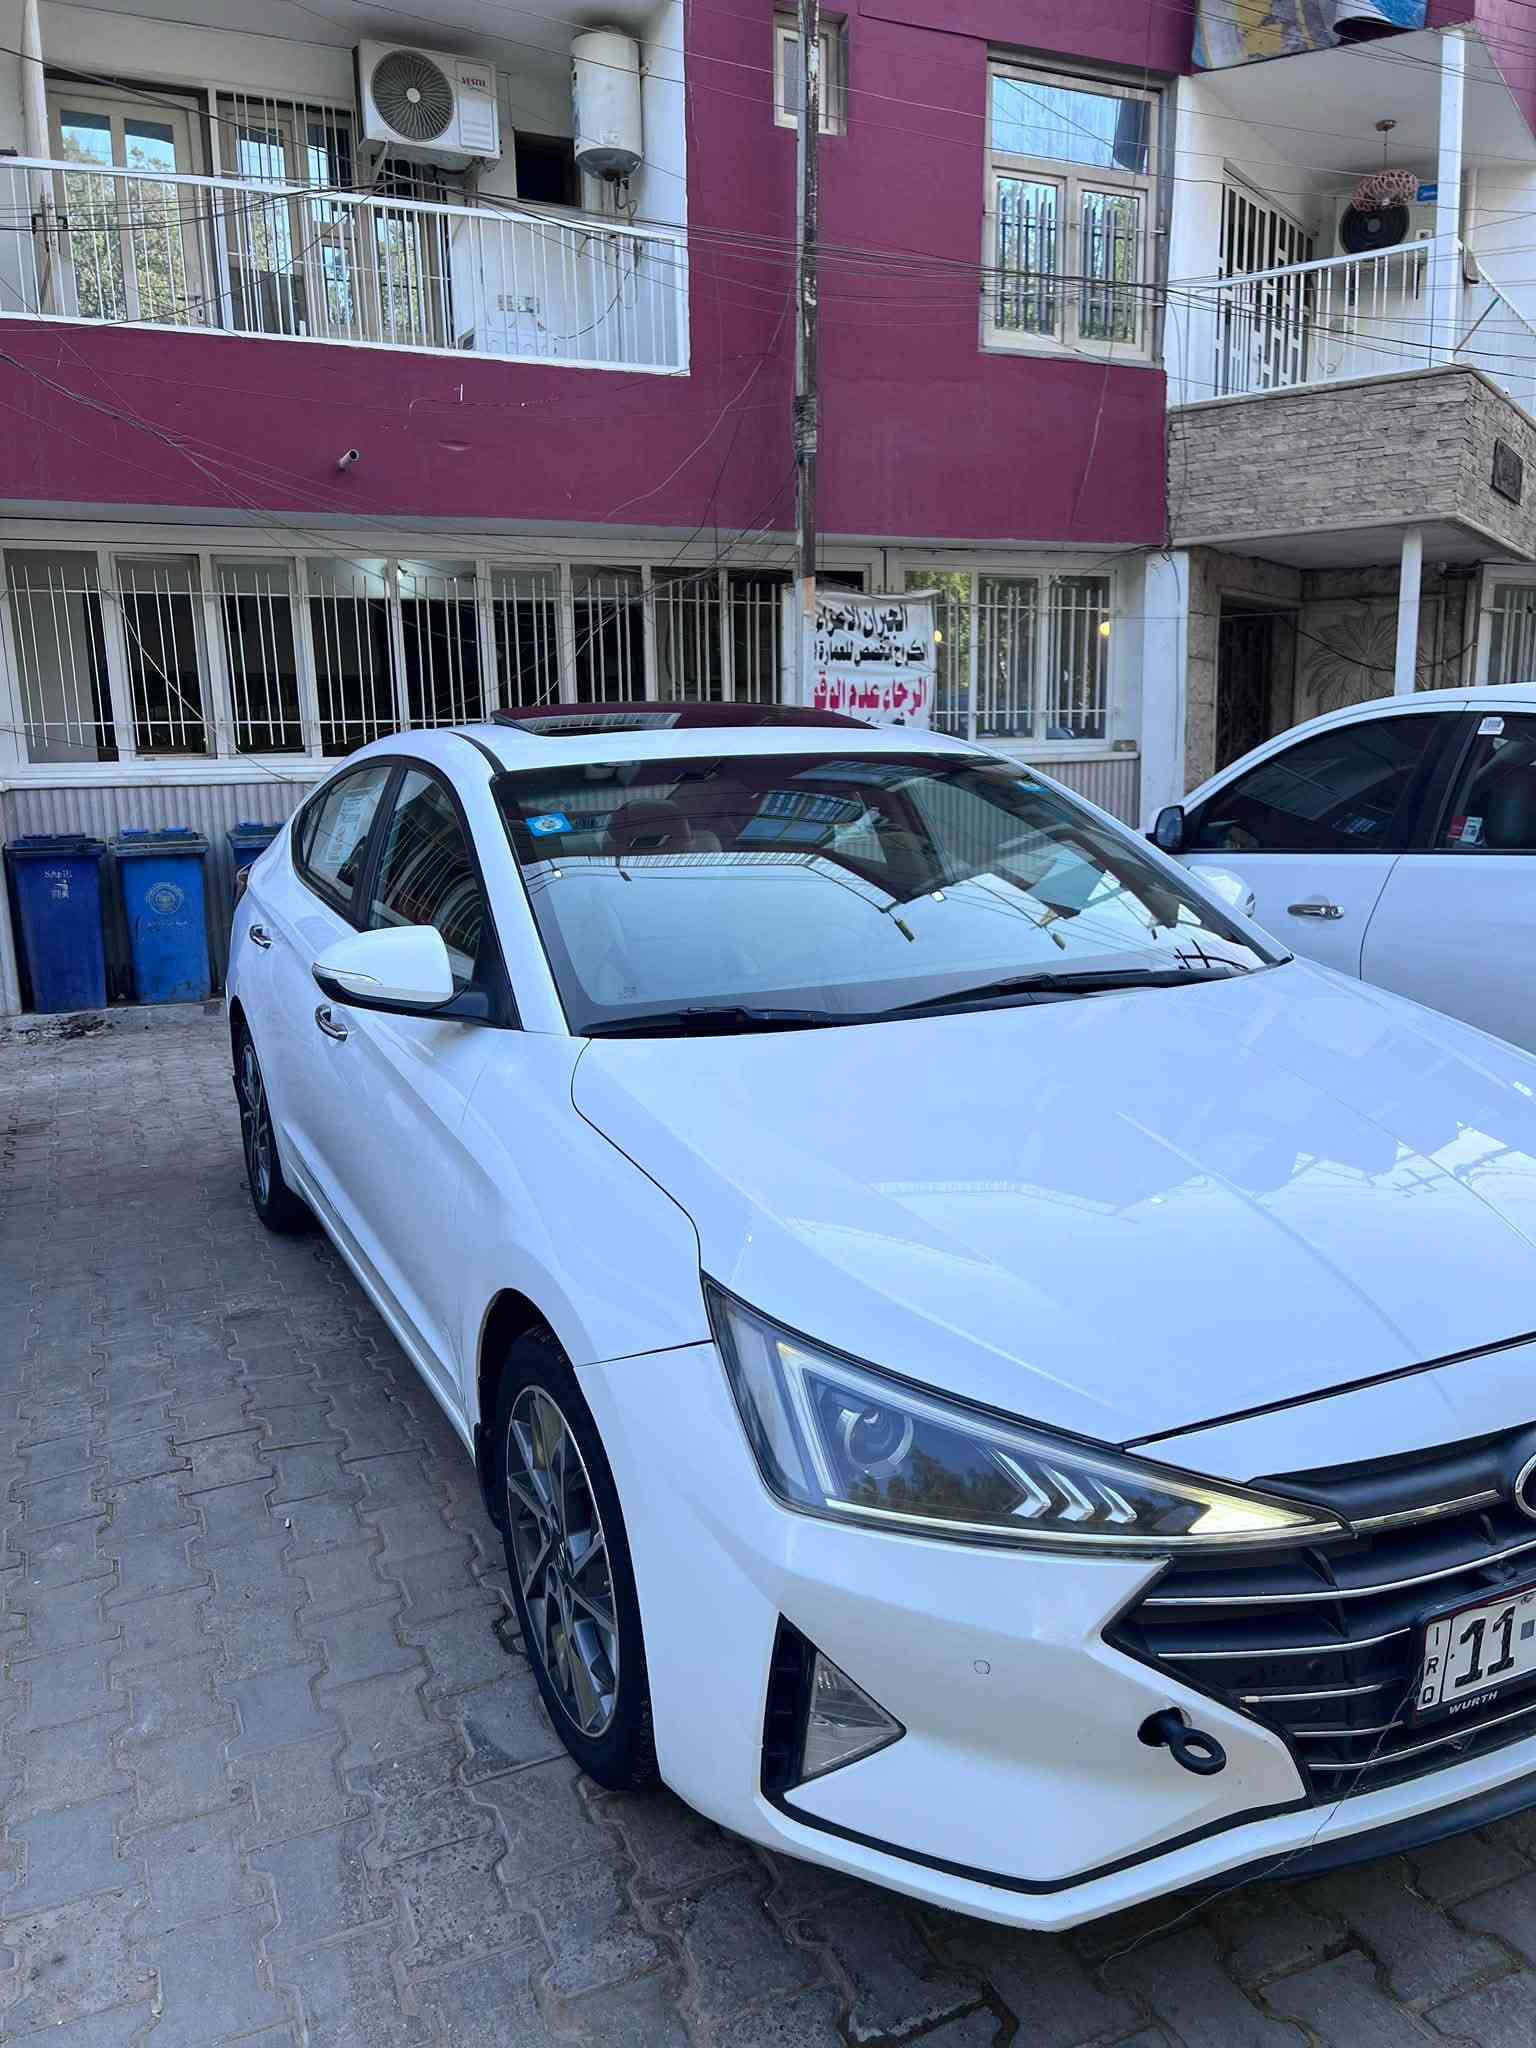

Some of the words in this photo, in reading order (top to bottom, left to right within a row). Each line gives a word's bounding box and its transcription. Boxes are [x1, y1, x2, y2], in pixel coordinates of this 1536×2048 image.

[848, 680, 880, 718] عدم
[882, 676, 927, 717] الرجاء
[1454, 1605, 1517, 1689] 11
[1448, 1690, 1499, 1714] WURTH
